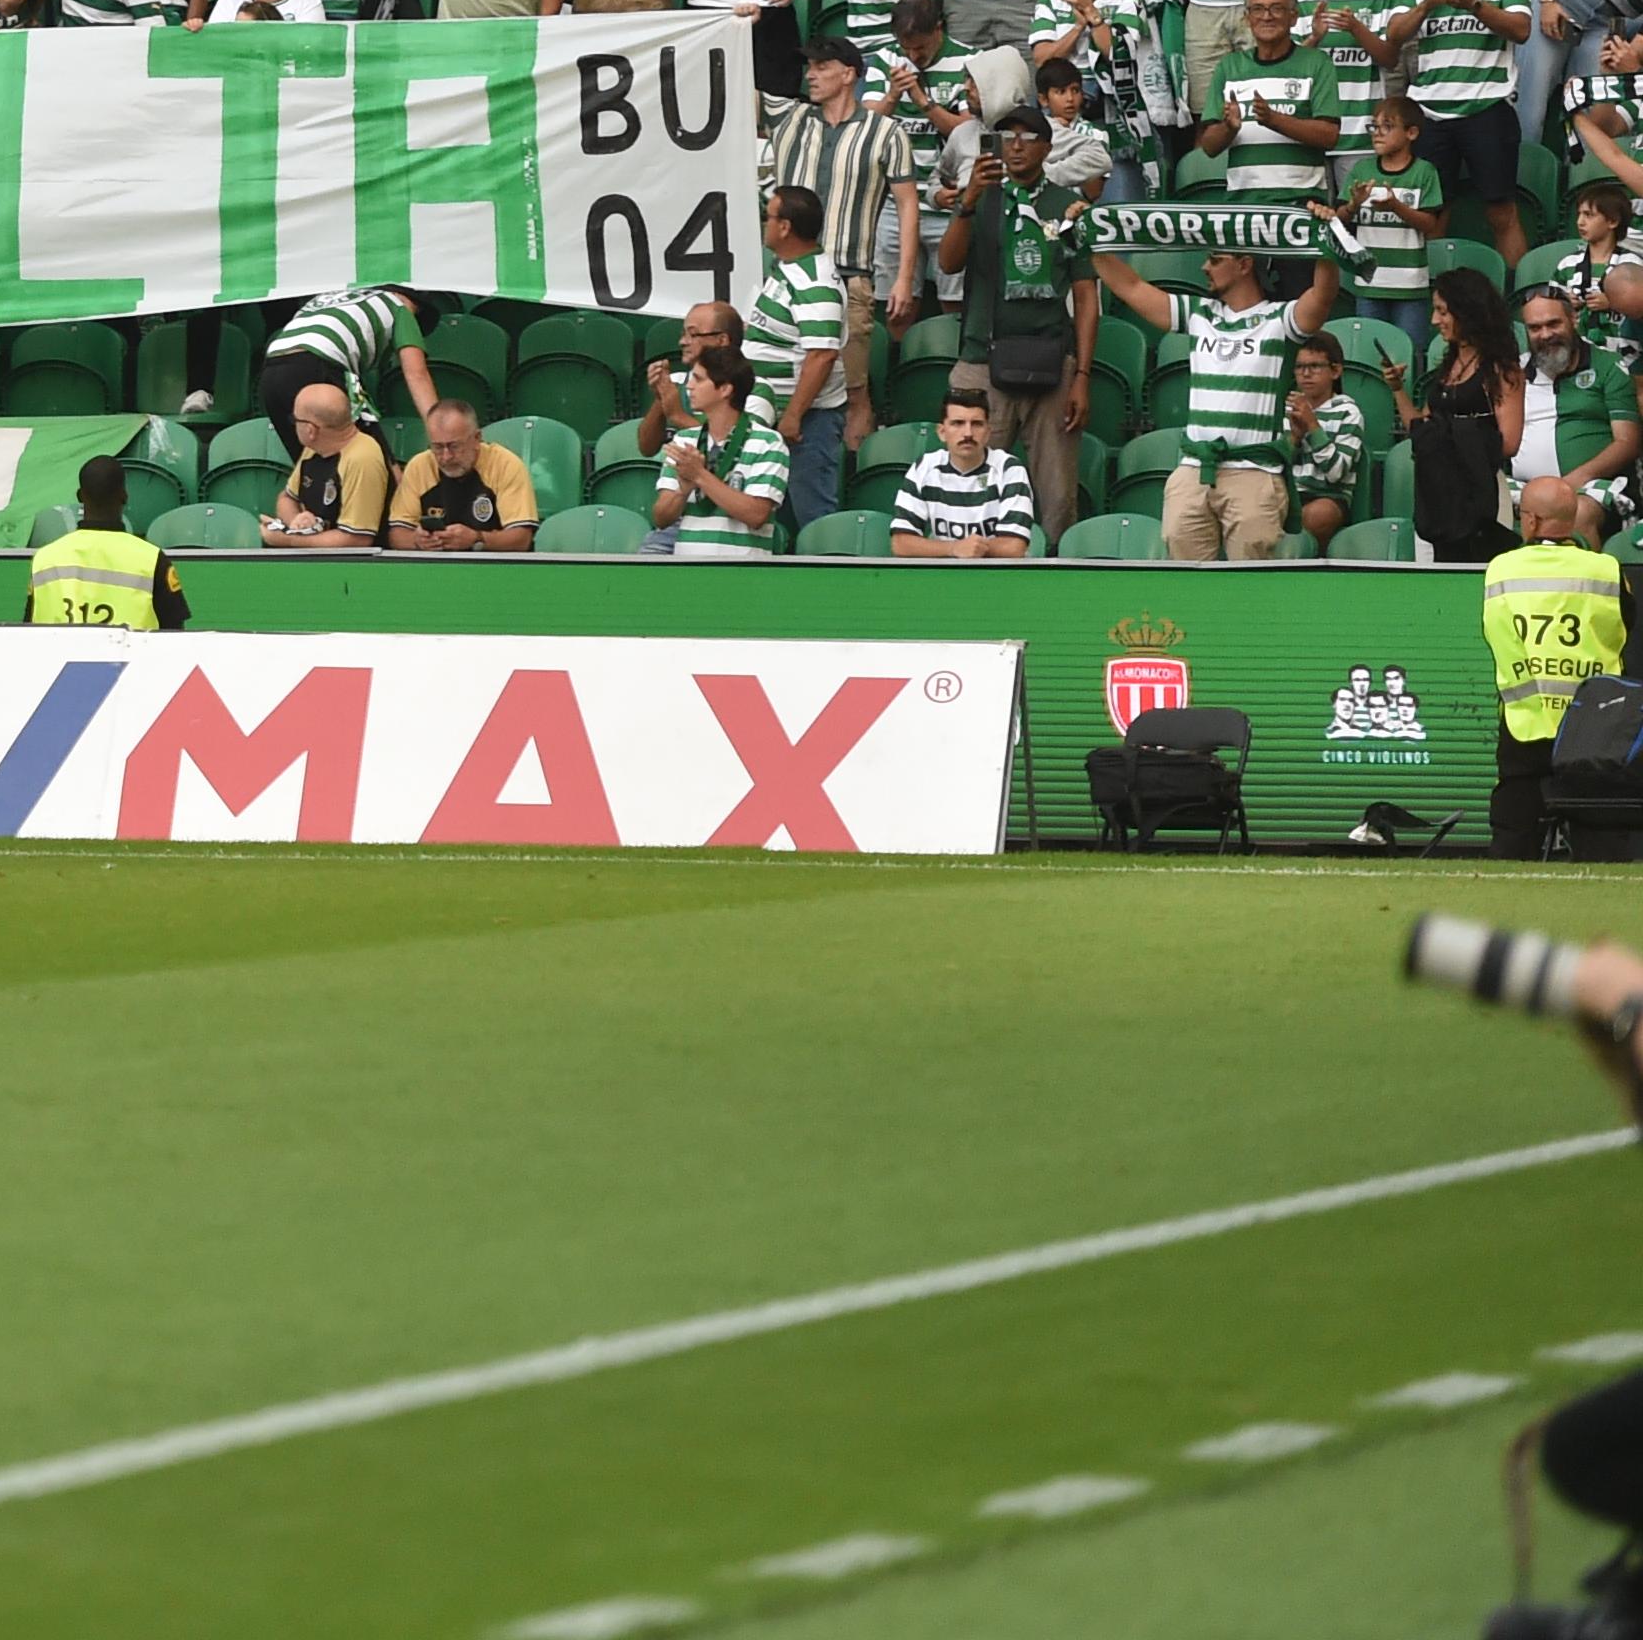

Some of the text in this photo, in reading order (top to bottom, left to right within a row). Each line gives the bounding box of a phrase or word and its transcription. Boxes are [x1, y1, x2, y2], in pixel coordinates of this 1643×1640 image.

[1425, 13, 1486, 36] Betano
[1327, 44, 1370, 63] tano
[578, 46, 727, 156] BU
[1090, 204, 1309, 248] SPORTING
[1373, 209, 1407, 224] BETA
[584, 191, 735, 311] 04
[1125, 667, 1170, 679] MONACO
[1322, 750, 1431, 765] CINCO VIOLINOS
